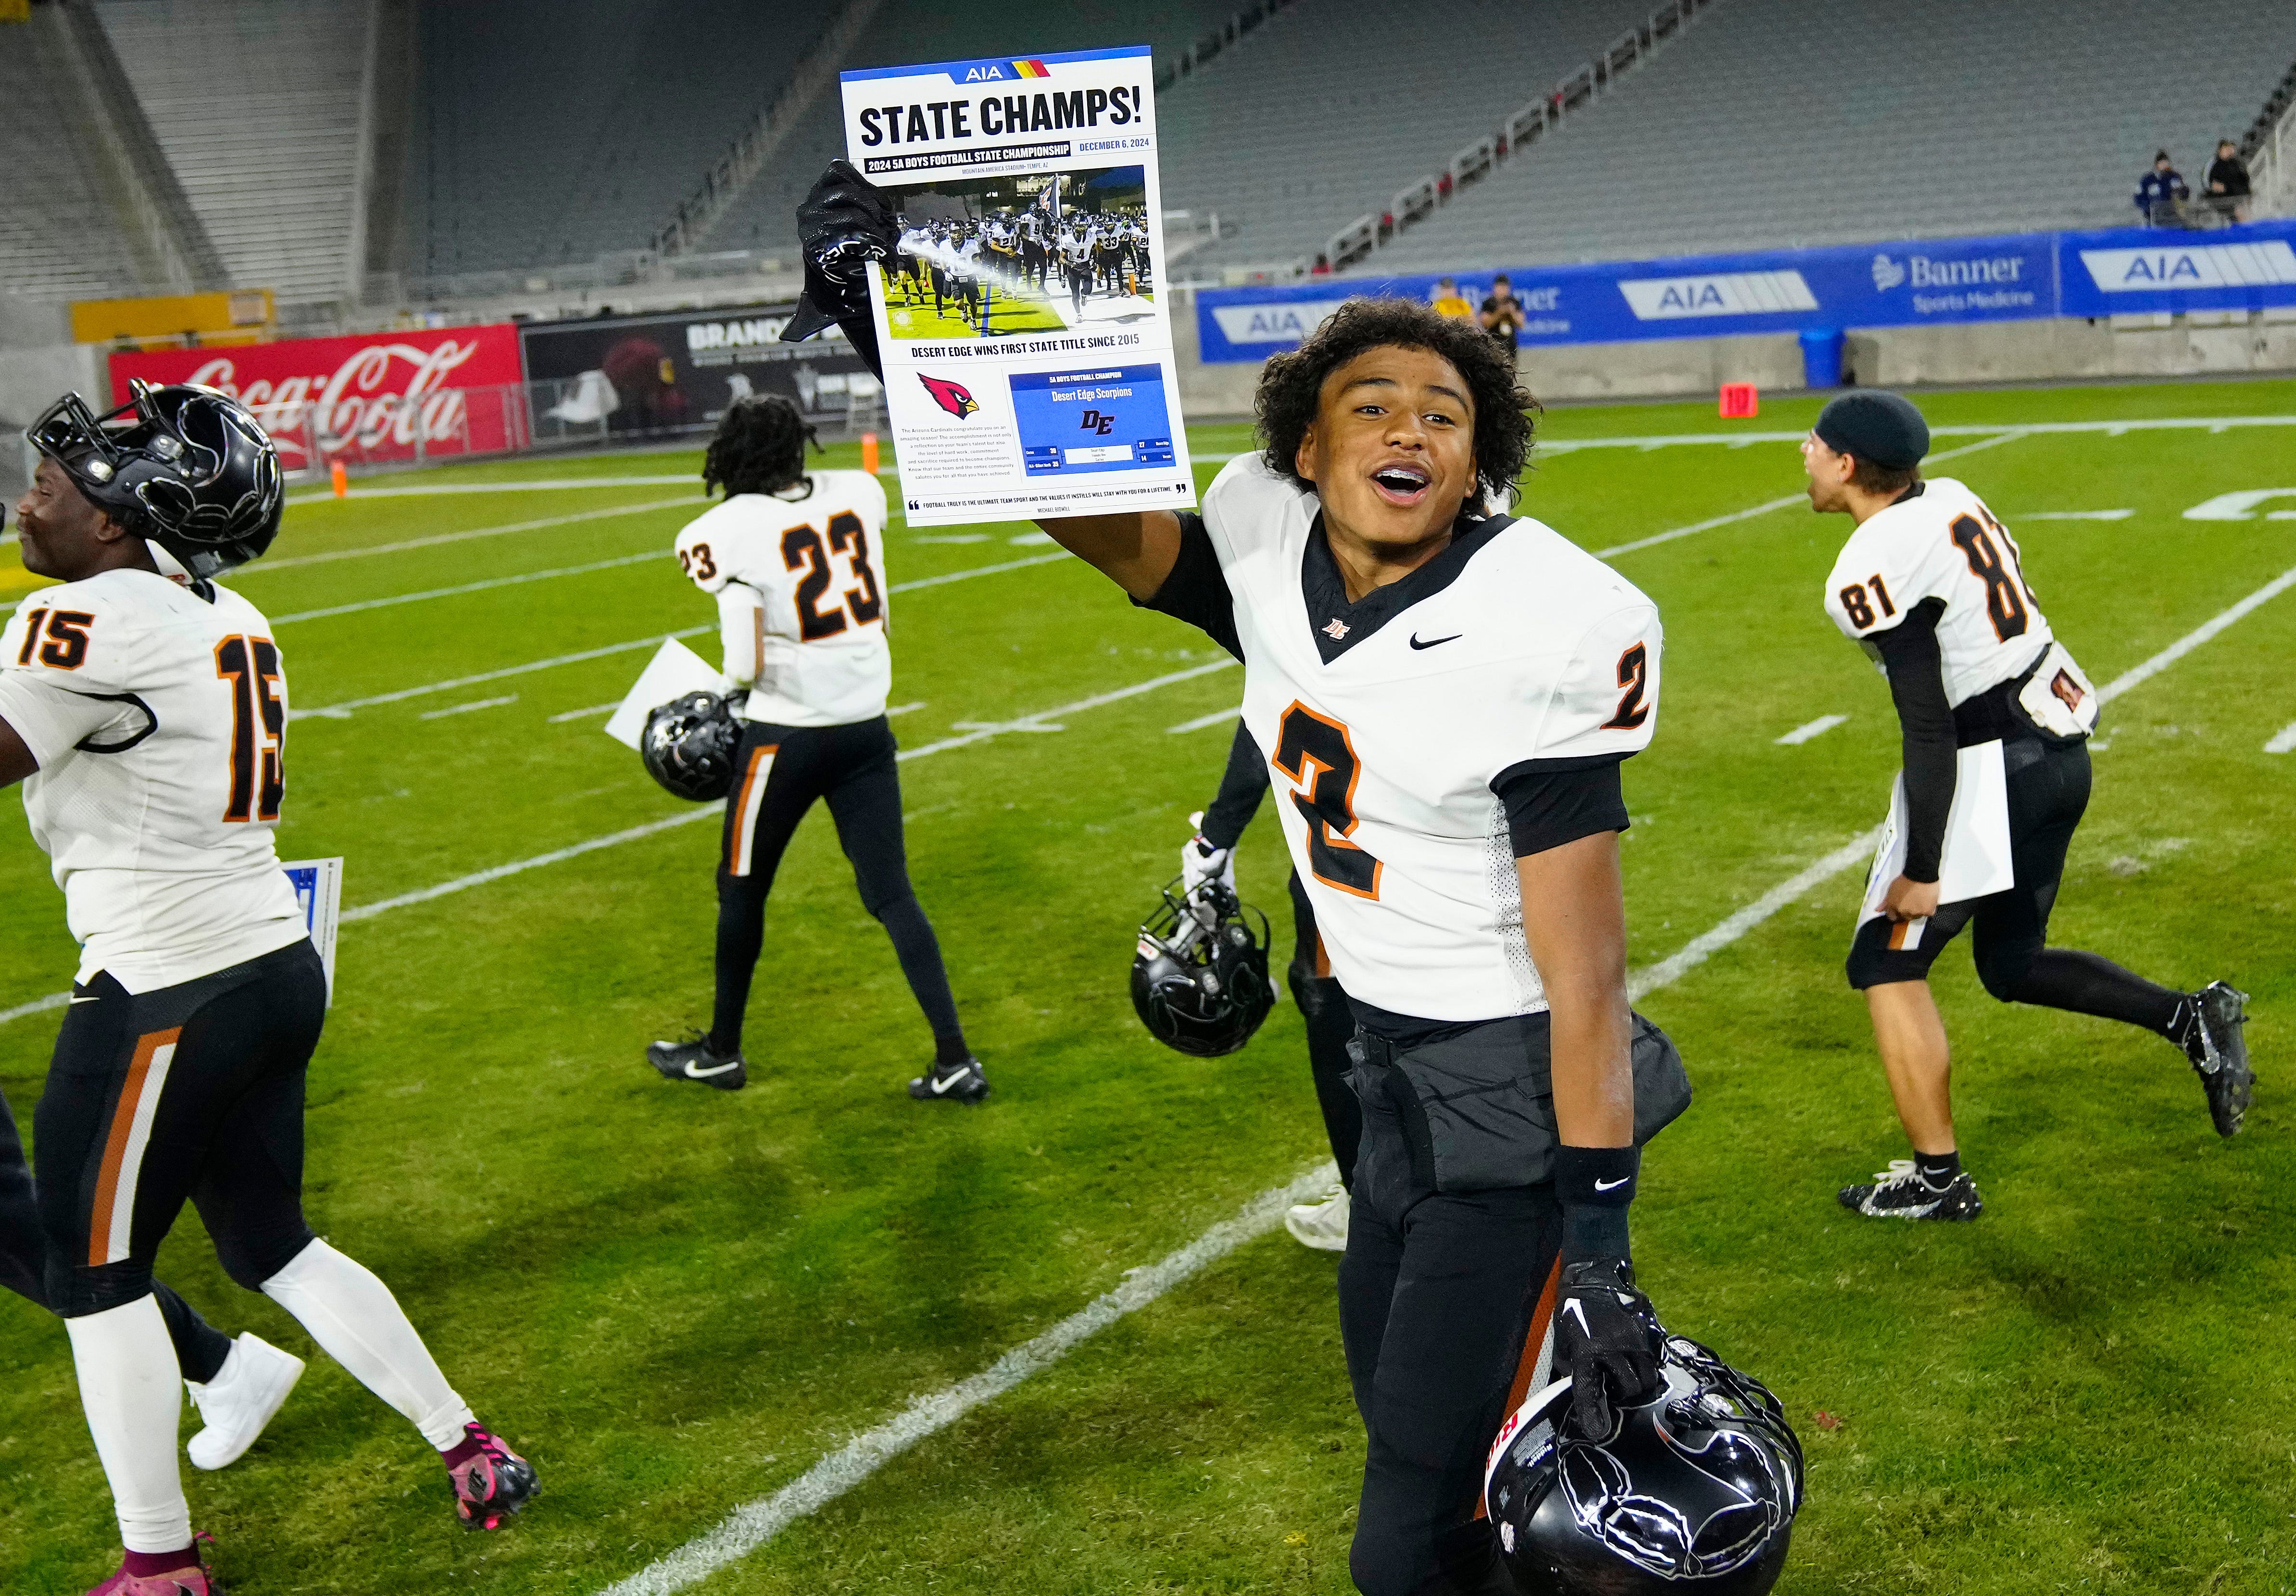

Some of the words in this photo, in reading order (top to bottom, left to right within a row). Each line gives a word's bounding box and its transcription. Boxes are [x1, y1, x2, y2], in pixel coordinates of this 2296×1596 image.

[965, 65, 1003, 82] AIA
[860, 100, 971, 146] STATE
[980, 86, 1141, 136] CHAMPS!
[868, 160, 891, 171] 2024
[893, 159, 904, 169] 5A
[905, 156, 928, 168] BOYS
[930, 152, 973, 166] FOOTBALL
[974, 150, 1002, 162] STATE
[1003, 144, 1069, 160] CHAMPIONSHIP
[1080, 140, 1120, 151] DECEMBER
[1122, 140, 1129, 149] 6,
[1130, 138, 1149, 148] 2024
[1077, 249, 1084, 260] 4
[1104, 237, 1117, 247] 33
[1910, 255, 2024, 287] Banner
[2123, 255, 2200, 282] AIA
[1658, 283, 1725, 311] AIA
[1913, 293, 1965, 314] Sports
[1967, 290, 2034, 311] Medicine
[1249, 309, 1304, 335] AIA
[912, 347, 946, 358] DESERT
[948, 346, 972, 357] EDGE
[974, 344, 999, 356] WINS
[1001, 343, 1027, 354] FIRST
[1029, 341, 1058, 352] STATE
[1060, 339, 1086, 350] TITLE
[1088, 337, 1116, 348] SINCE
[1117, 334, 1139, 346] 2015
[189, 339, 479, 453] ca-Cola
[1052, 391, 1076, 402] Desert
[1077, 389, 1095, 402] Edge
[1096, 387, 1132, 399] Scorpions
[1079, 409, 1116, 436] DE
[779, 509, 884, 643] 23
[1839, 574, 1896, 630] 81
[18, 608, 95, 671] 15
[1322, 618, 1351, 640] DE
[1600, 640, 1651, 730] 2
[213, 634, 284, 822] 15
[1272, 698, 1383, 902] 2
